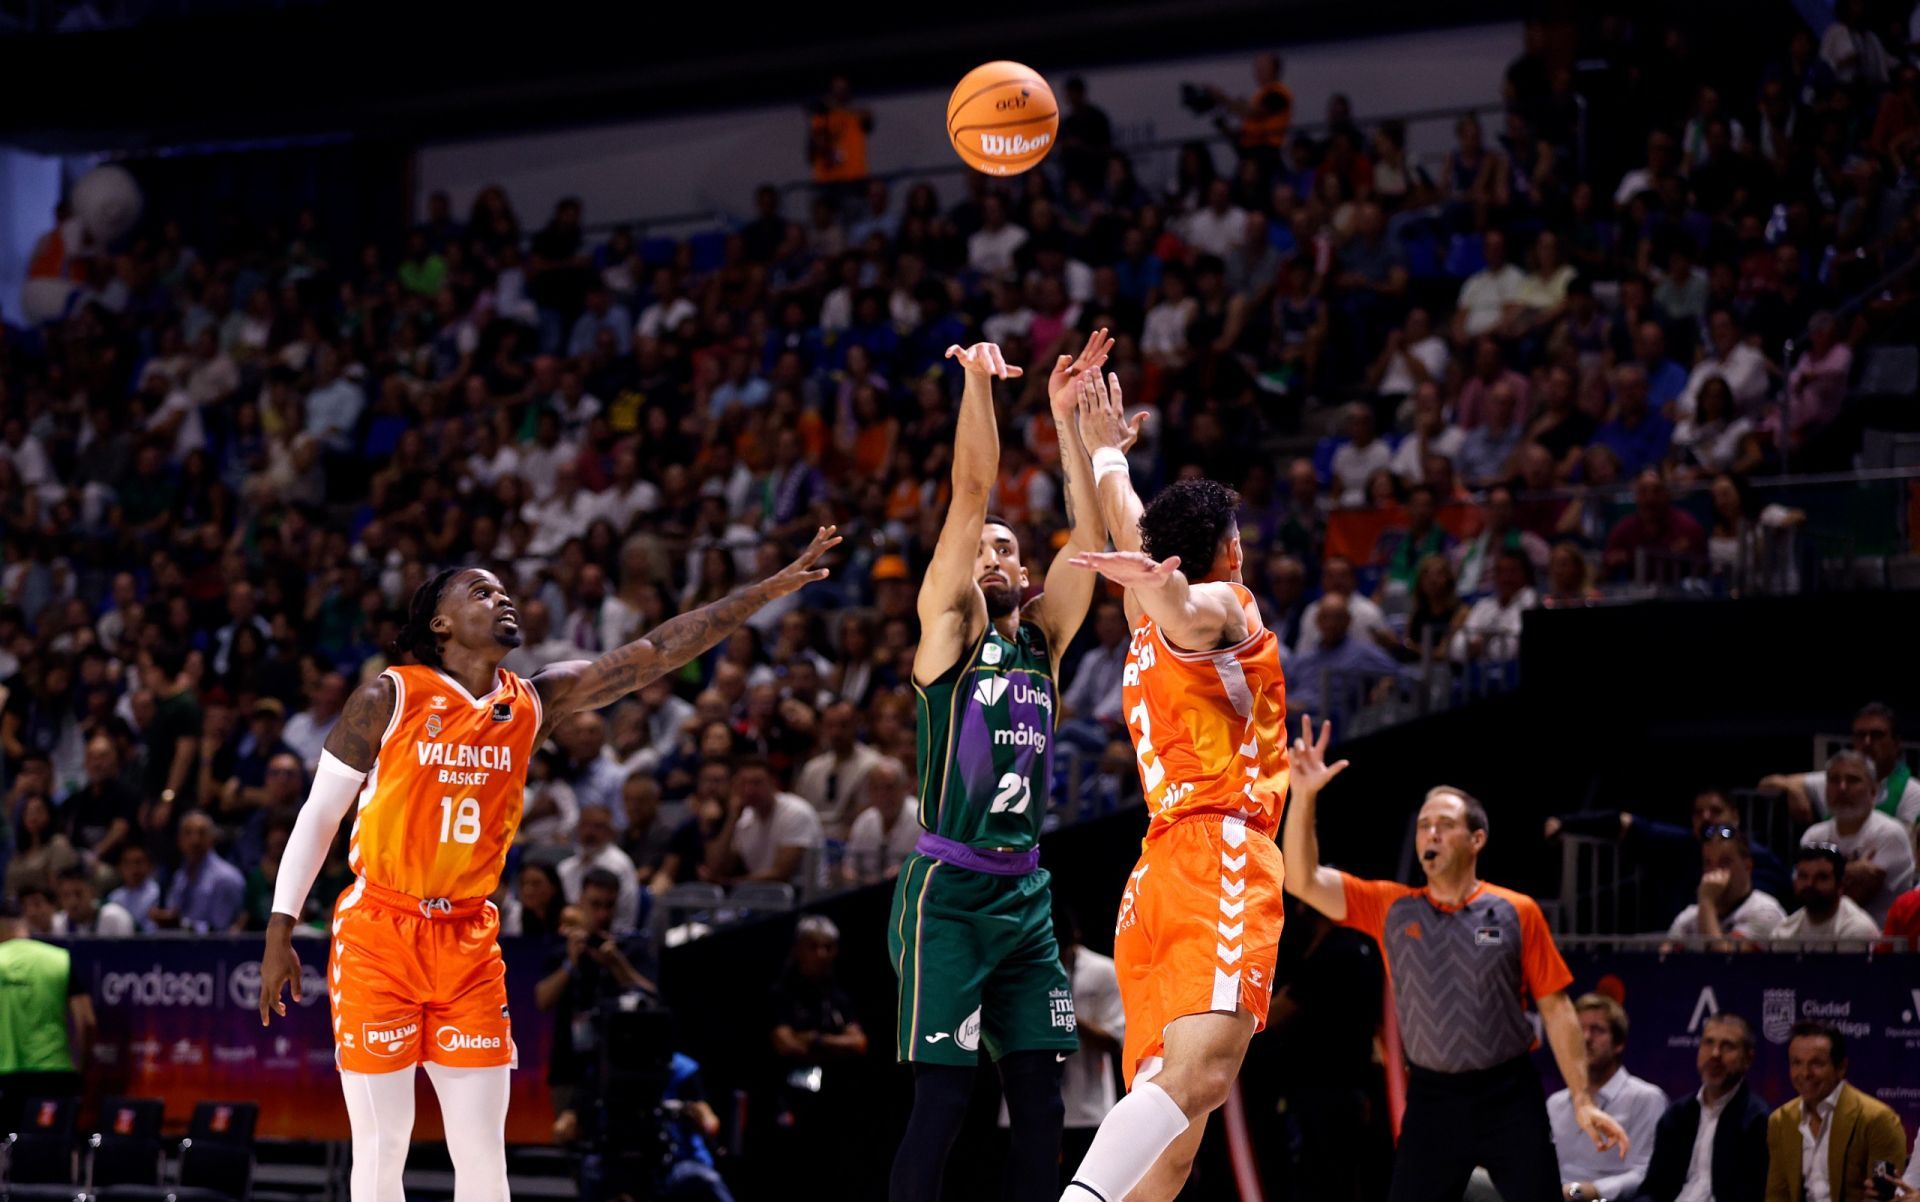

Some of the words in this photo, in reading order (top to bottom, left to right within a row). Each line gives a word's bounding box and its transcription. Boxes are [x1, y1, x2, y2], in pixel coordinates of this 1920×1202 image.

[995, 95, 1026, 111] acb
[980, 133, 1050, 156] Wilson
[416, 740, 512, 772] VALENCIA
[438, 769, 490, 785] BASKET
[989, 772, 1031, 814] 21
[440, 796, 481, 844] 18
[102, 963, 214, 1005] endesa
[1802, 1000, 1851, 1017] Ciudad
[367, 1023, 418, 1044] PULEVA
[447, 1032, 501, 1049] Midea
